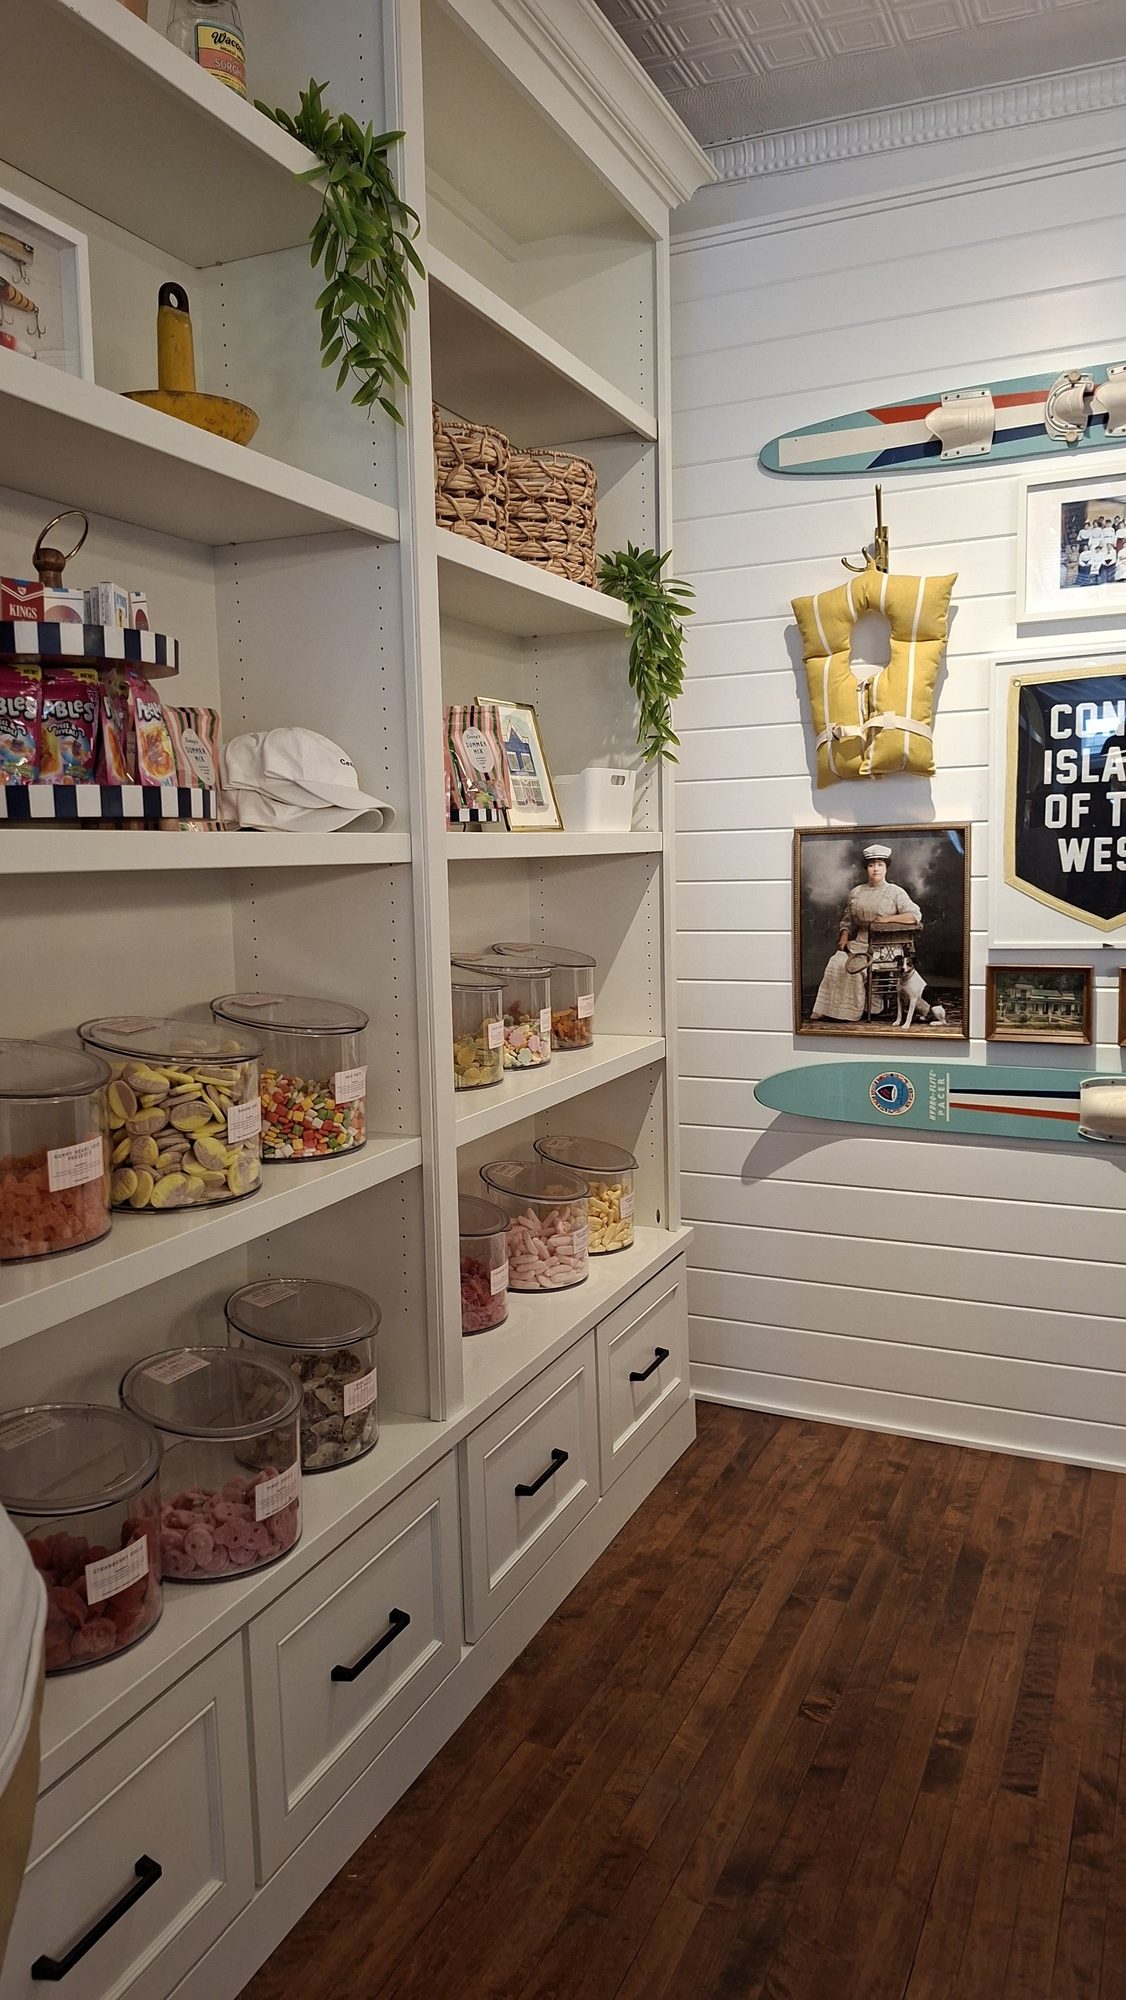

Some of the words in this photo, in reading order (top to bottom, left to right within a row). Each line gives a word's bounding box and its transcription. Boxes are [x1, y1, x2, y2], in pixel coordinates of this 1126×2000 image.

[9, 603, 38, 619] KINGS
[1050, 700, 1126, 740] CON
[1043, 747, 1126, 785] ISLA
[1044, 793, 1091, 829] OF
[1106, 791, 1126, 827] T
